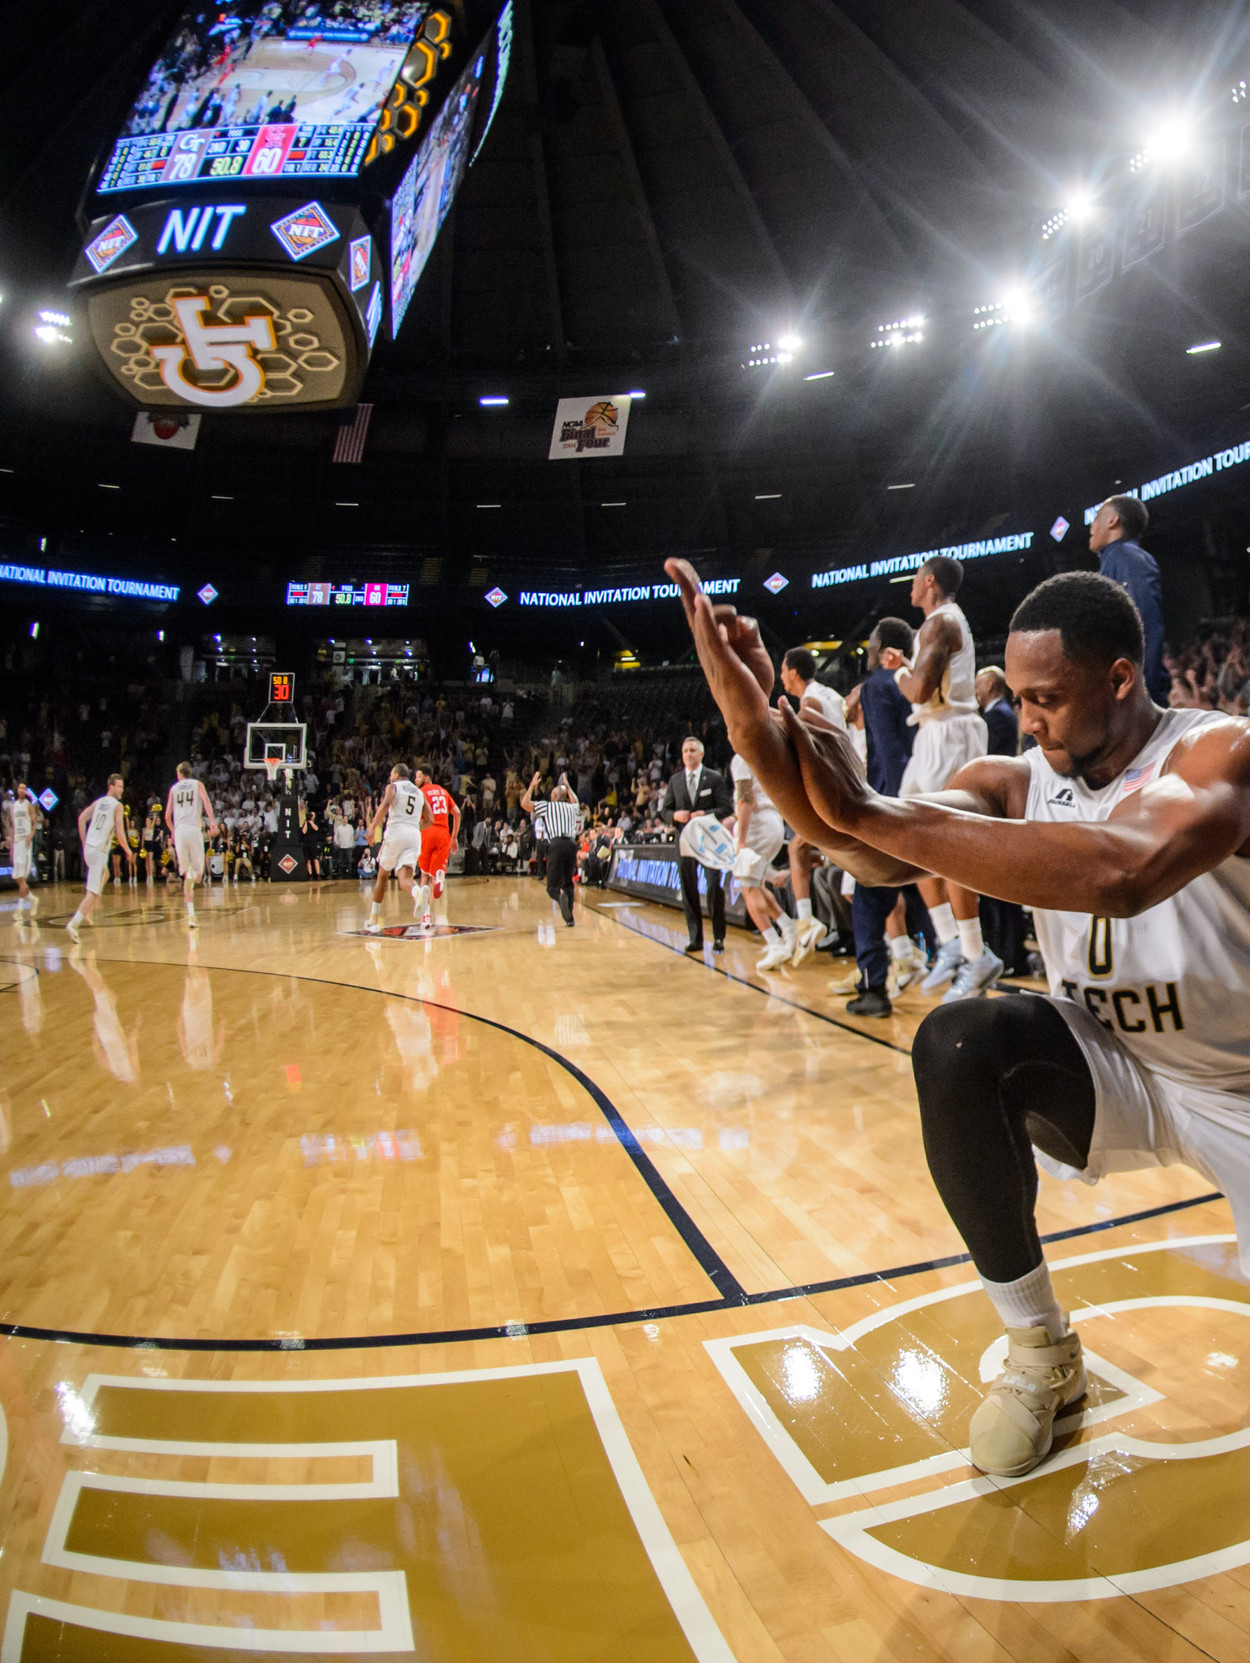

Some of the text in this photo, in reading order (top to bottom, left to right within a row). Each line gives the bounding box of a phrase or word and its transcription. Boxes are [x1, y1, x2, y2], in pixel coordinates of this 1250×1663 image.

[169, 153, 197, 180] 78
[210, 155, 244, 177] 50.8
[251, 147, 283, 174] 60
[156, 204, 247, 255] NIT
[287, 222, 324, 240] NIT
[559, 425, 597, 443] Final
[562, 420, 583, 428] NCAA
[575, 437, 611, 453] Four
[1141, 457, 1214, 502] INVITATION
[47, 570, 106, 592] INVITATION
[107, 578, 180, 602] TOURNAMENT
[811, 564, 870, 588] NATIONAL
[312, 591, 323, 604] 78
[335, 593, 352, 604] 50.8
[370, 591, 381, 604] 60
[520, 592, 583, 606] NATIONAL
[583, 586, 651, 604] INVITATION
[273, 684, 289, 700] 30
[177, 790, 194, 808] 44
[405, 795, 416, 816] 5
[432, 796, 447, 815] 23
[95, 813, 107, 831] 10
[639, 859, 671, 888] INVITATION
[1087, 913, 1115, 980] 0
[1061, 978, 1186, 1034] TECH
